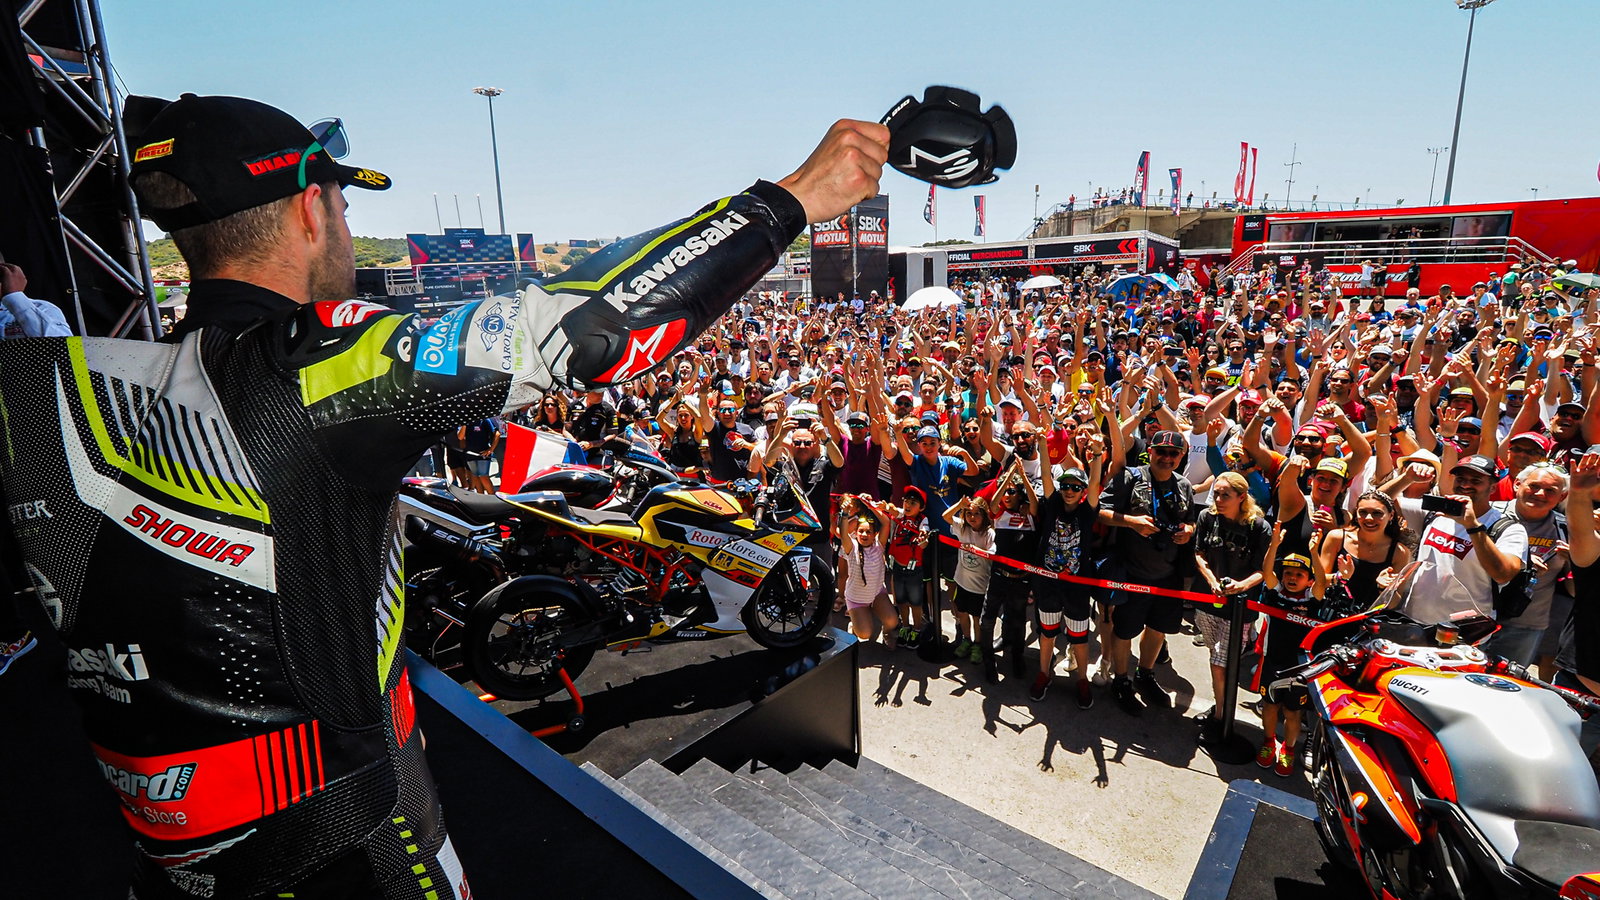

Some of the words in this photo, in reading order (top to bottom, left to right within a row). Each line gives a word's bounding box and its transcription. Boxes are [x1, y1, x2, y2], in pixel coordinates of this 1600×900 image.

[246, 151, 317, 176] DIAB
[858, 215, 882, 231] SBK
[815, 231, 847, 244] MOTUL
[859, 233, 885, 243] MOTUL
[949, 253, 970, 261] FFICIAL
[971, 249, 1024, 260] MERCHANDISING
[1073, 244, 1091, 254] SBK
[603, 210, 750, 314] Kawasaki
[488, 317, 500, 332] CN
[501, 323, 515, 371] CAROLE
[9, 500, 53, 523] TER
[704, 500, 723, 511] KTM
[123, 504, 255, 567] SHOWA
[1106, 581, 1123, 590] SBK
[1286, 612, 1307, 625] SBK
[68, 643, 150, 681] asaki
[95, 675, 131, 704] Team
[1390, 677, 1430, 696] DUCATI
[143, 806, 188, 825] Store
